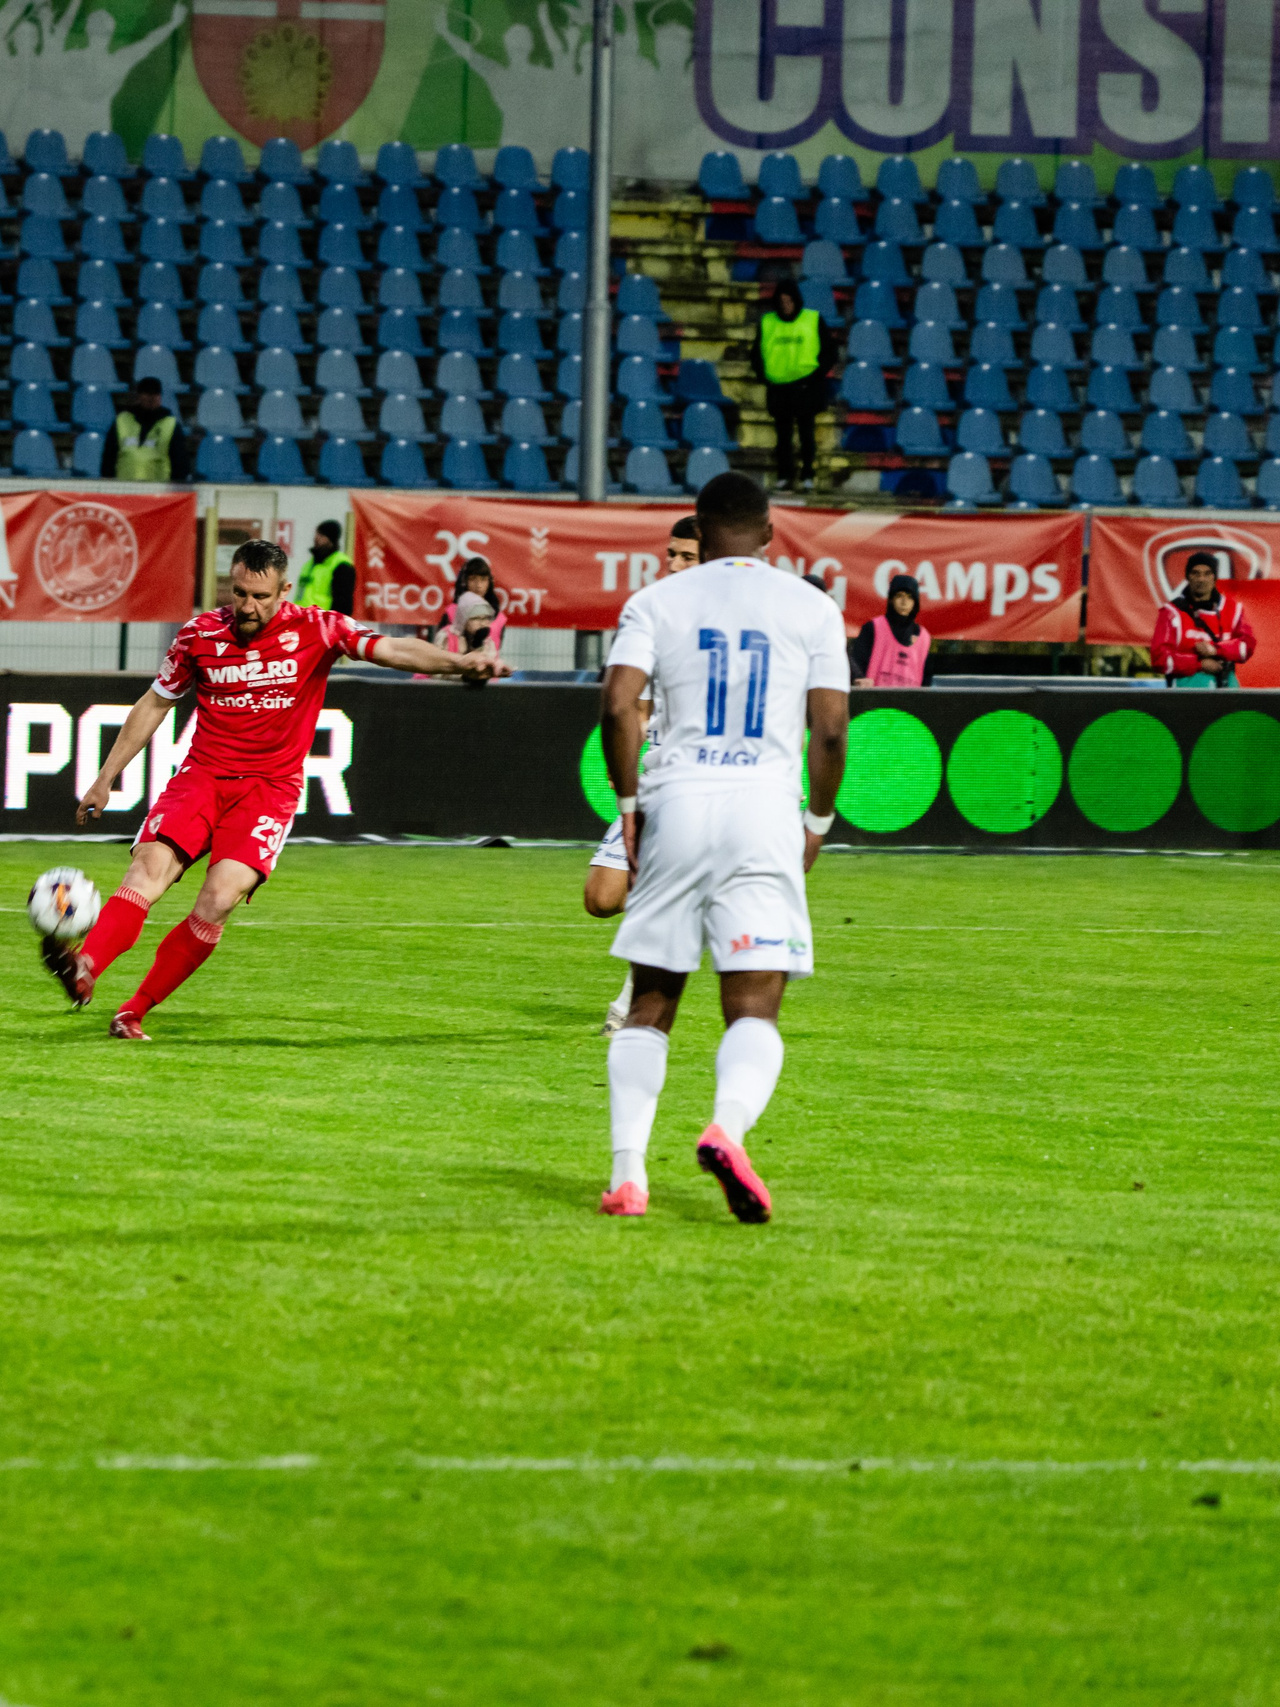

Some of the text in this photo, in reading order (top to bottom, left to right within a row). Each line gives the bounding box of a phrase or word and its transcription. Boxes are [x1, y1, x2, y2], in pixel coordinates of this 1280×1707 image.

[365, 582, 443, 611] RECO
[699, 628, 770, 738] 11
[4, 703, 354, 815] POKR
[250, 815, 284, 851] 23
